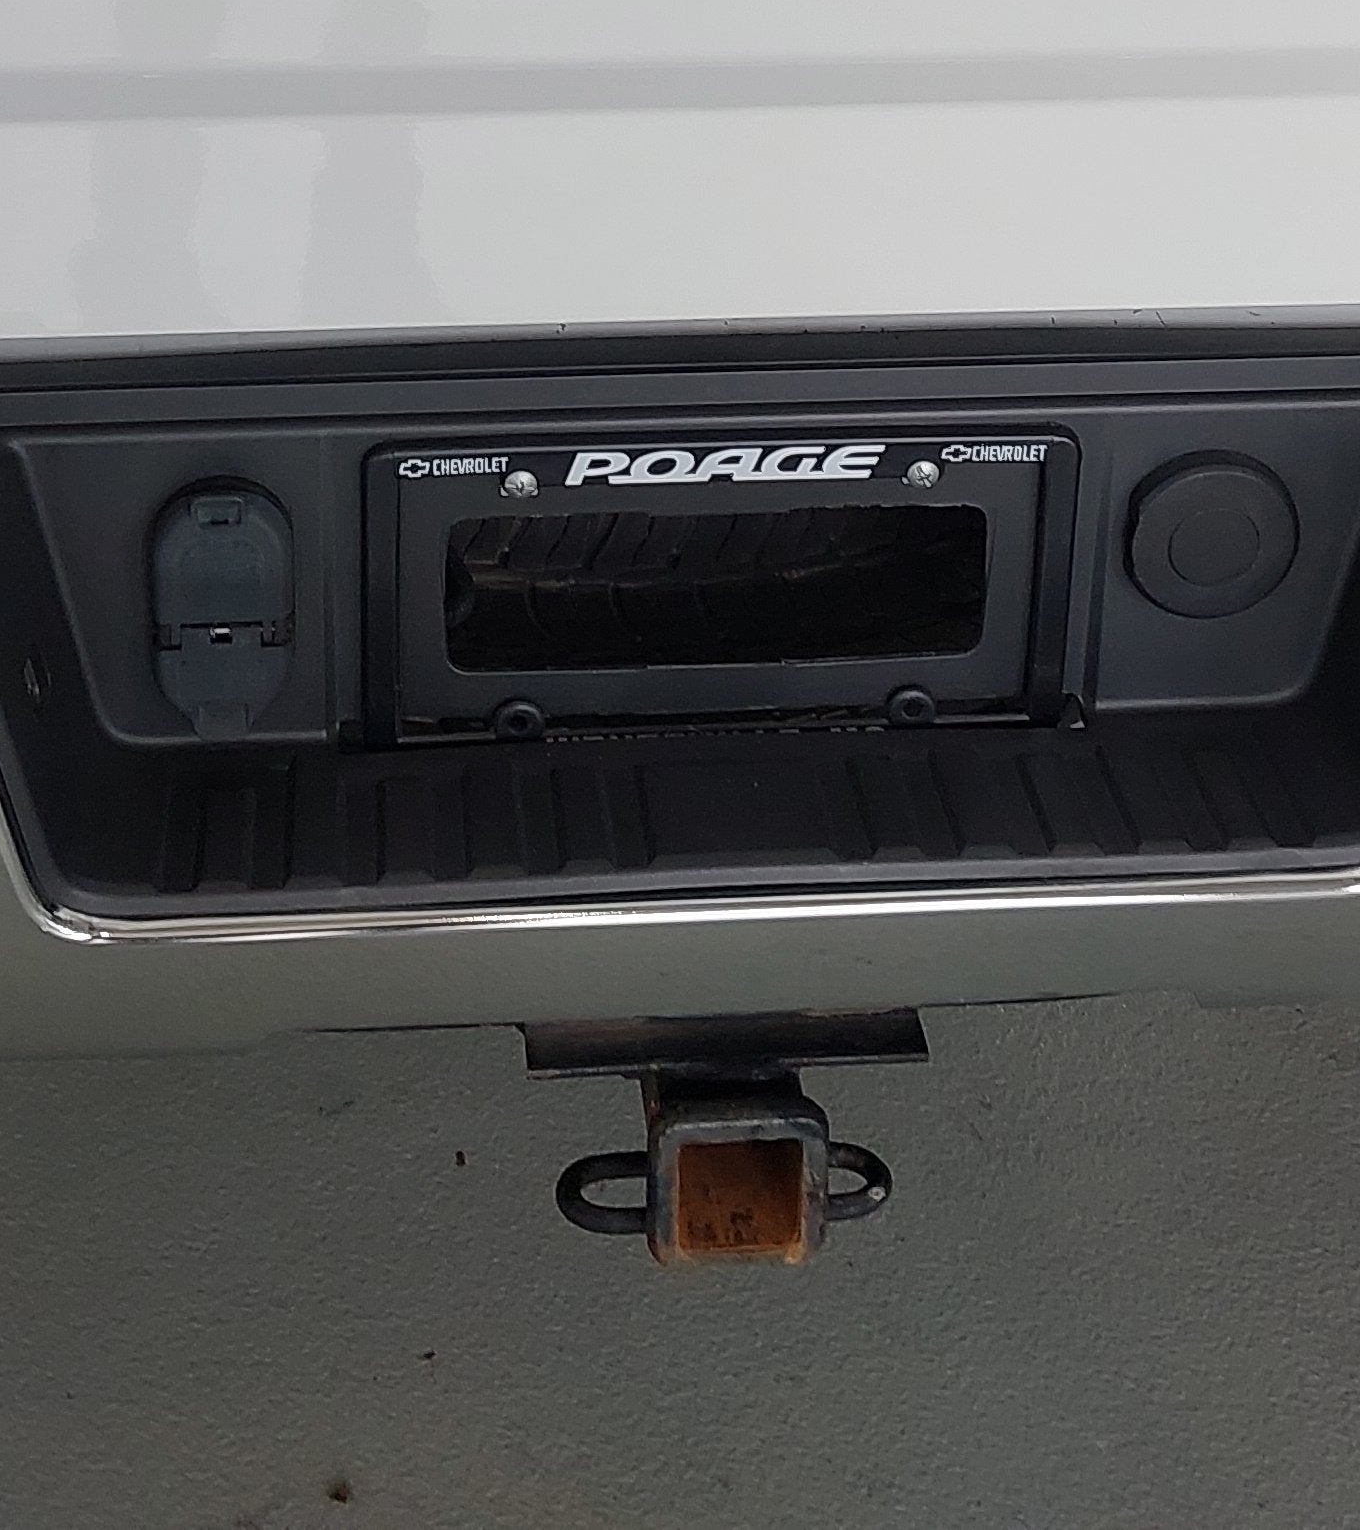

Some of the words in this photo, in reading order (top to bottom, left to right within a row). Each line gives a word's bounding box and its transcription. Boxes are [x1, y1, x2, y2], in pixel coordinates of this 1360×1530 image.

[972, 443, 1048, 463] CHEVROLET
[432, 456, 509, 476] CHEVROLET
[564, 444, 886, 486] POAGE
